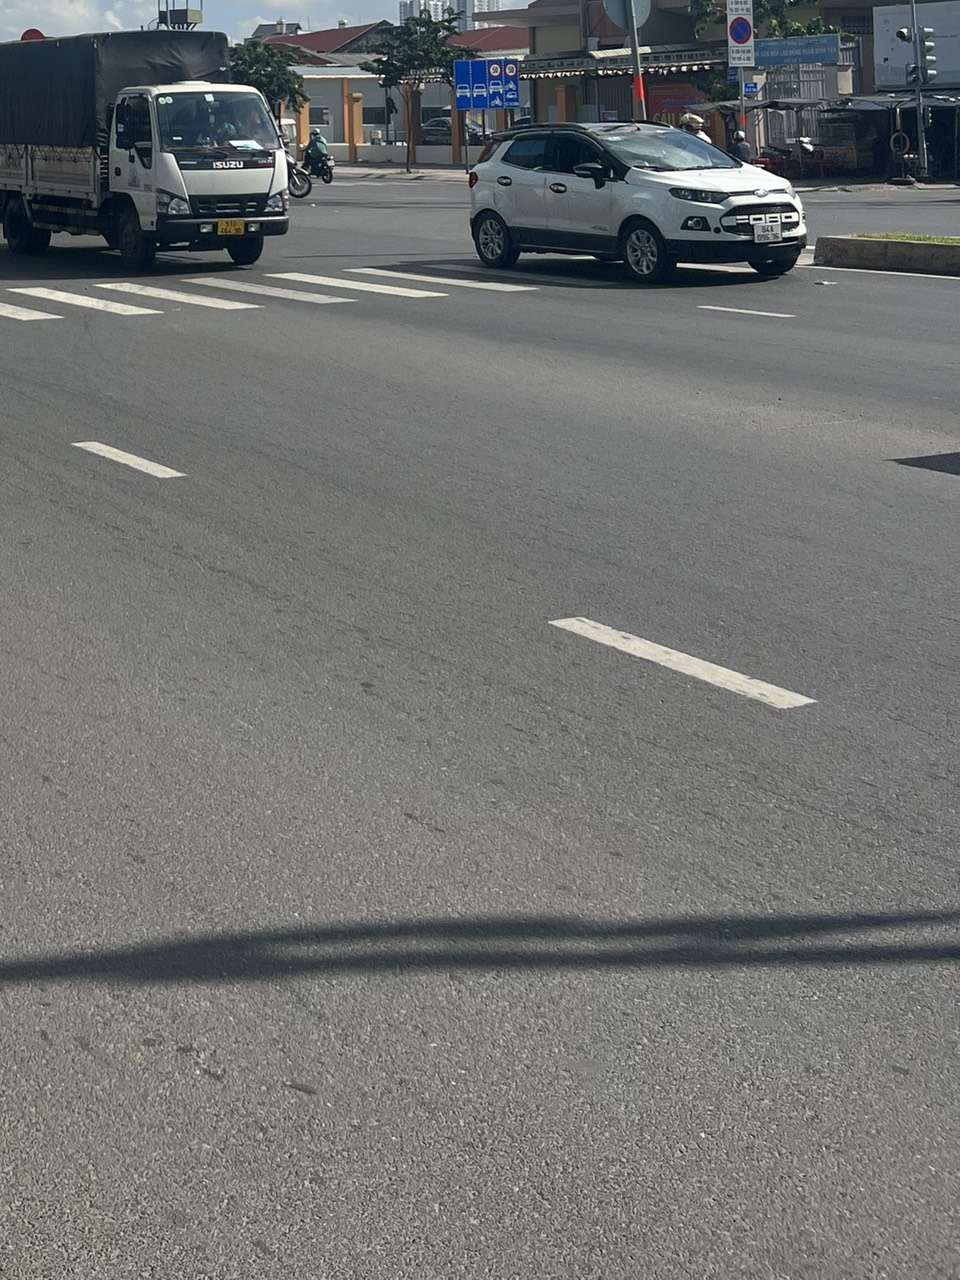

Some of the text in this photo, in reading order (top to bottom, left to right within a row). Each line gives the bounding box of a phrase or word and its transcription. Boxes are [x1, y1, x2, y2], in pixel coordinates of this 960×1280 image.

[492, 66, 499, 74] 50
[508, 66, 515, 74] 50
[212, 160, 244, 169] ISUZU
